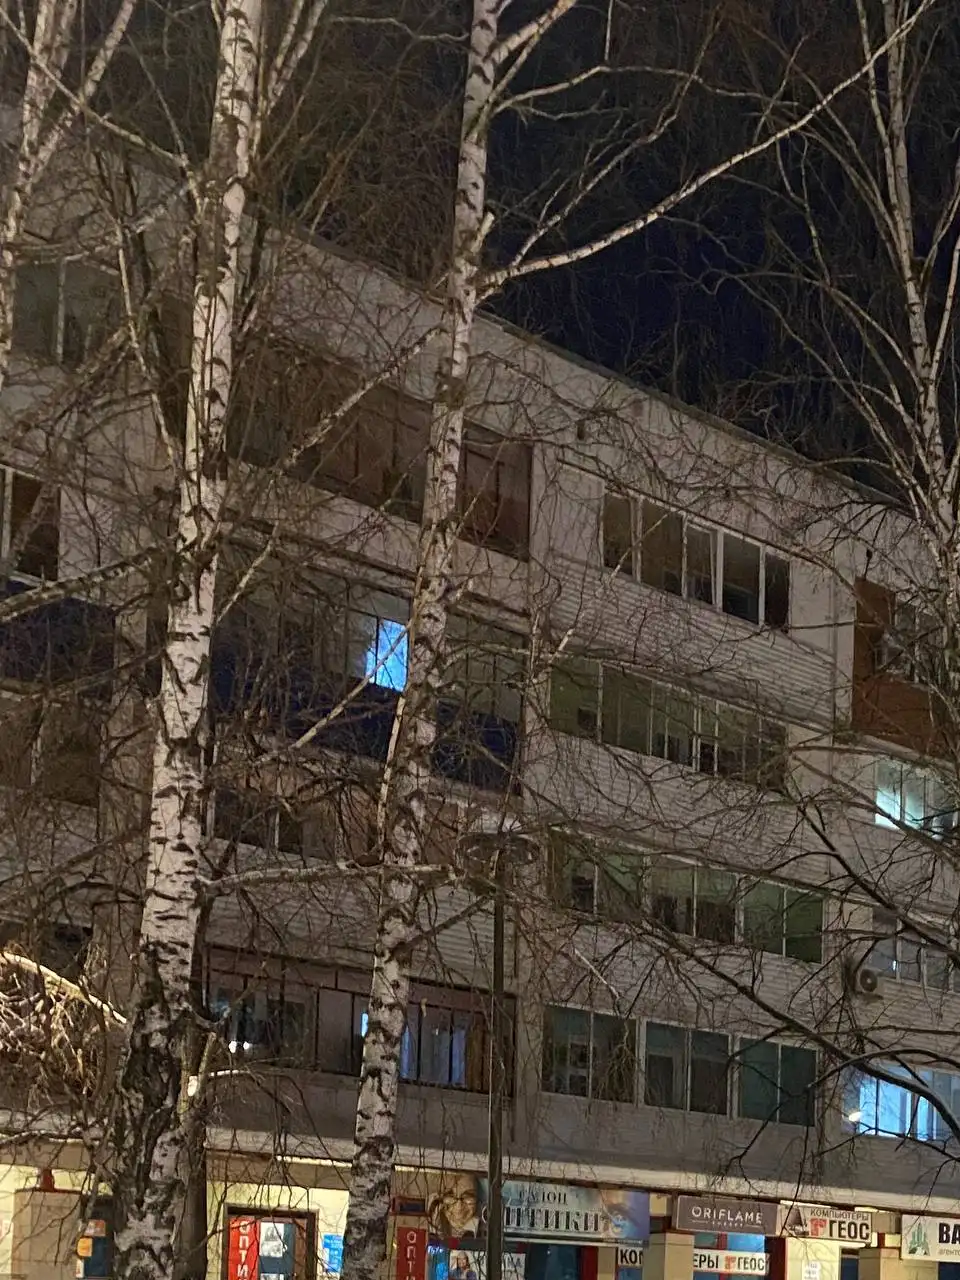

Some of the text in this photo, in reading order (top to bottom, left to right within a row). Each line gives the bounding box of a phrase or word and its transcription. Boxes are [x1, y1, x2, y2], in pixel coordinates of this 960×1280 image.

[691, 1206, 763, 1224] ORIFLAME
[810, 1207, 869, 1221] КОМПЬЮТЕРЫ
[828, 1219, 870, 1240] ГЕОС
[737, 1256, 765, 1272] ГЕОС
